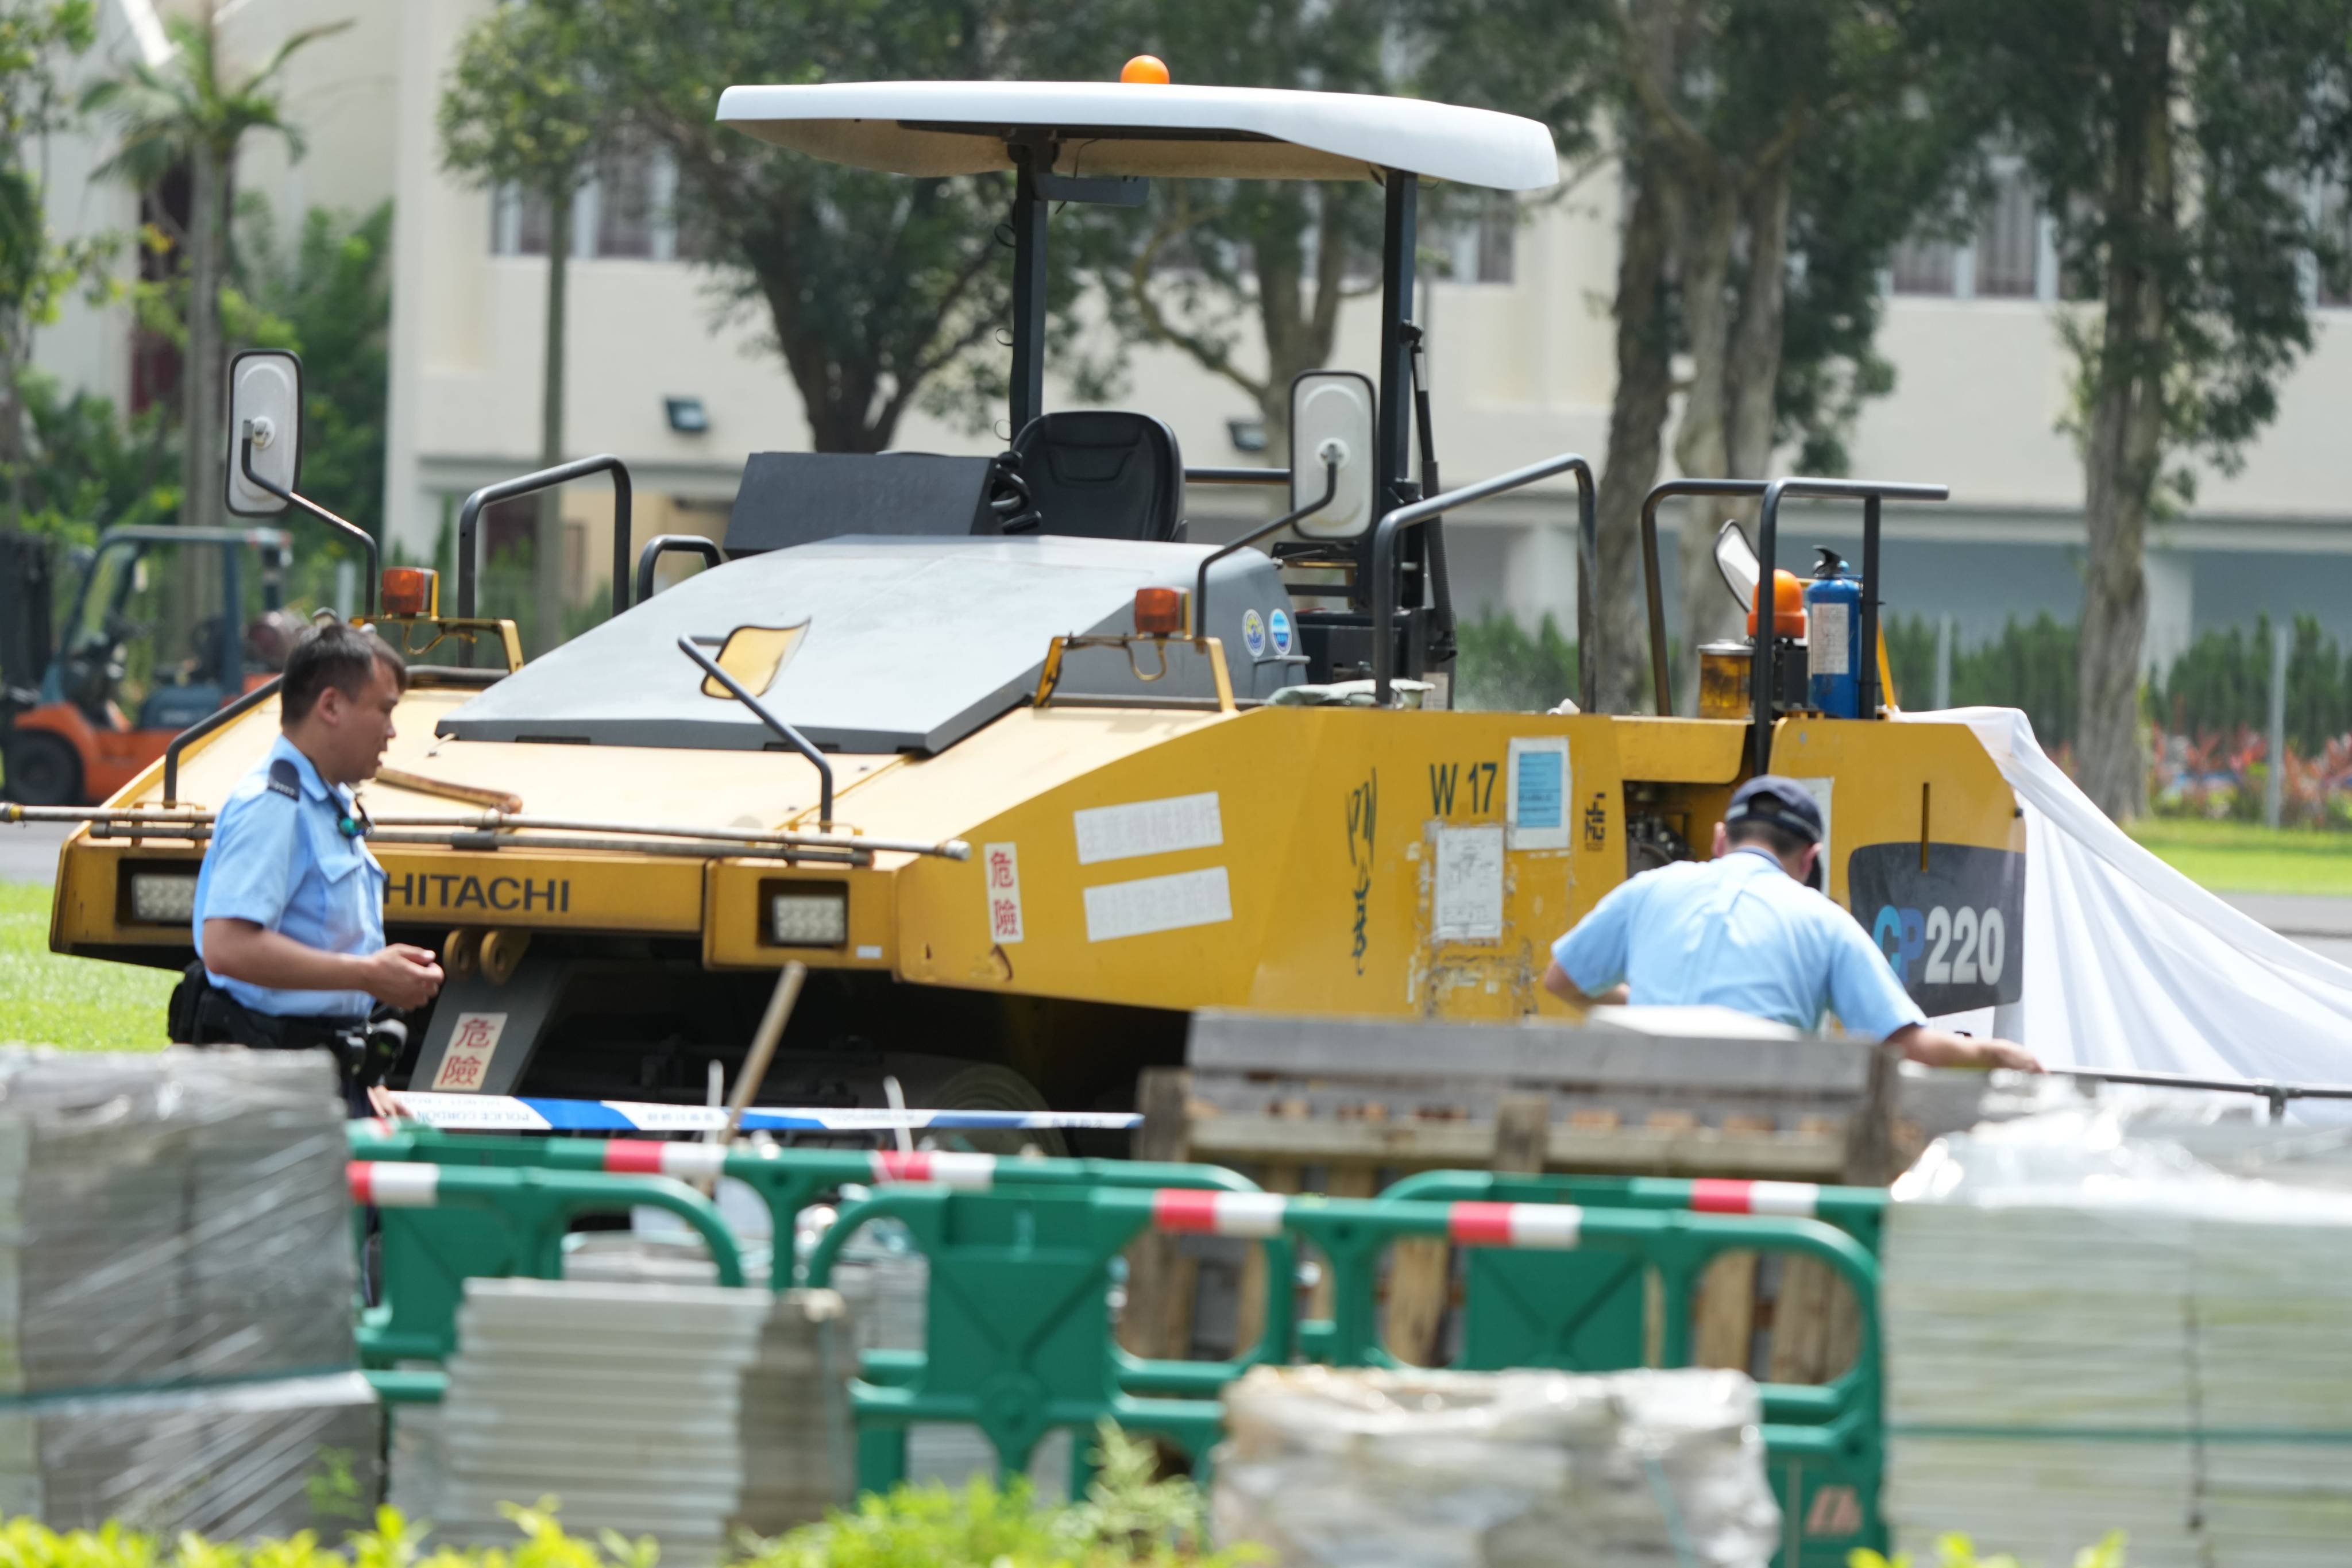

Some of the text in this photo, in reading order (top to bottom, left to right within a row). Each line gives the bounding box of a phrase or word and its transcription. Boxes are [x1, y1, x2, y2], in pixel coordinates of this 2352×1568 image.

[1429, 763, 1459, 816] W
[1467, 761, 1497, 814] 17
[383, 871, 570, 913] HITACHI
[989, 850, 1019, 937] 危險
[1873, 904, 2005, 986] CP220
[439, 1017, 495, 1088] 危險
